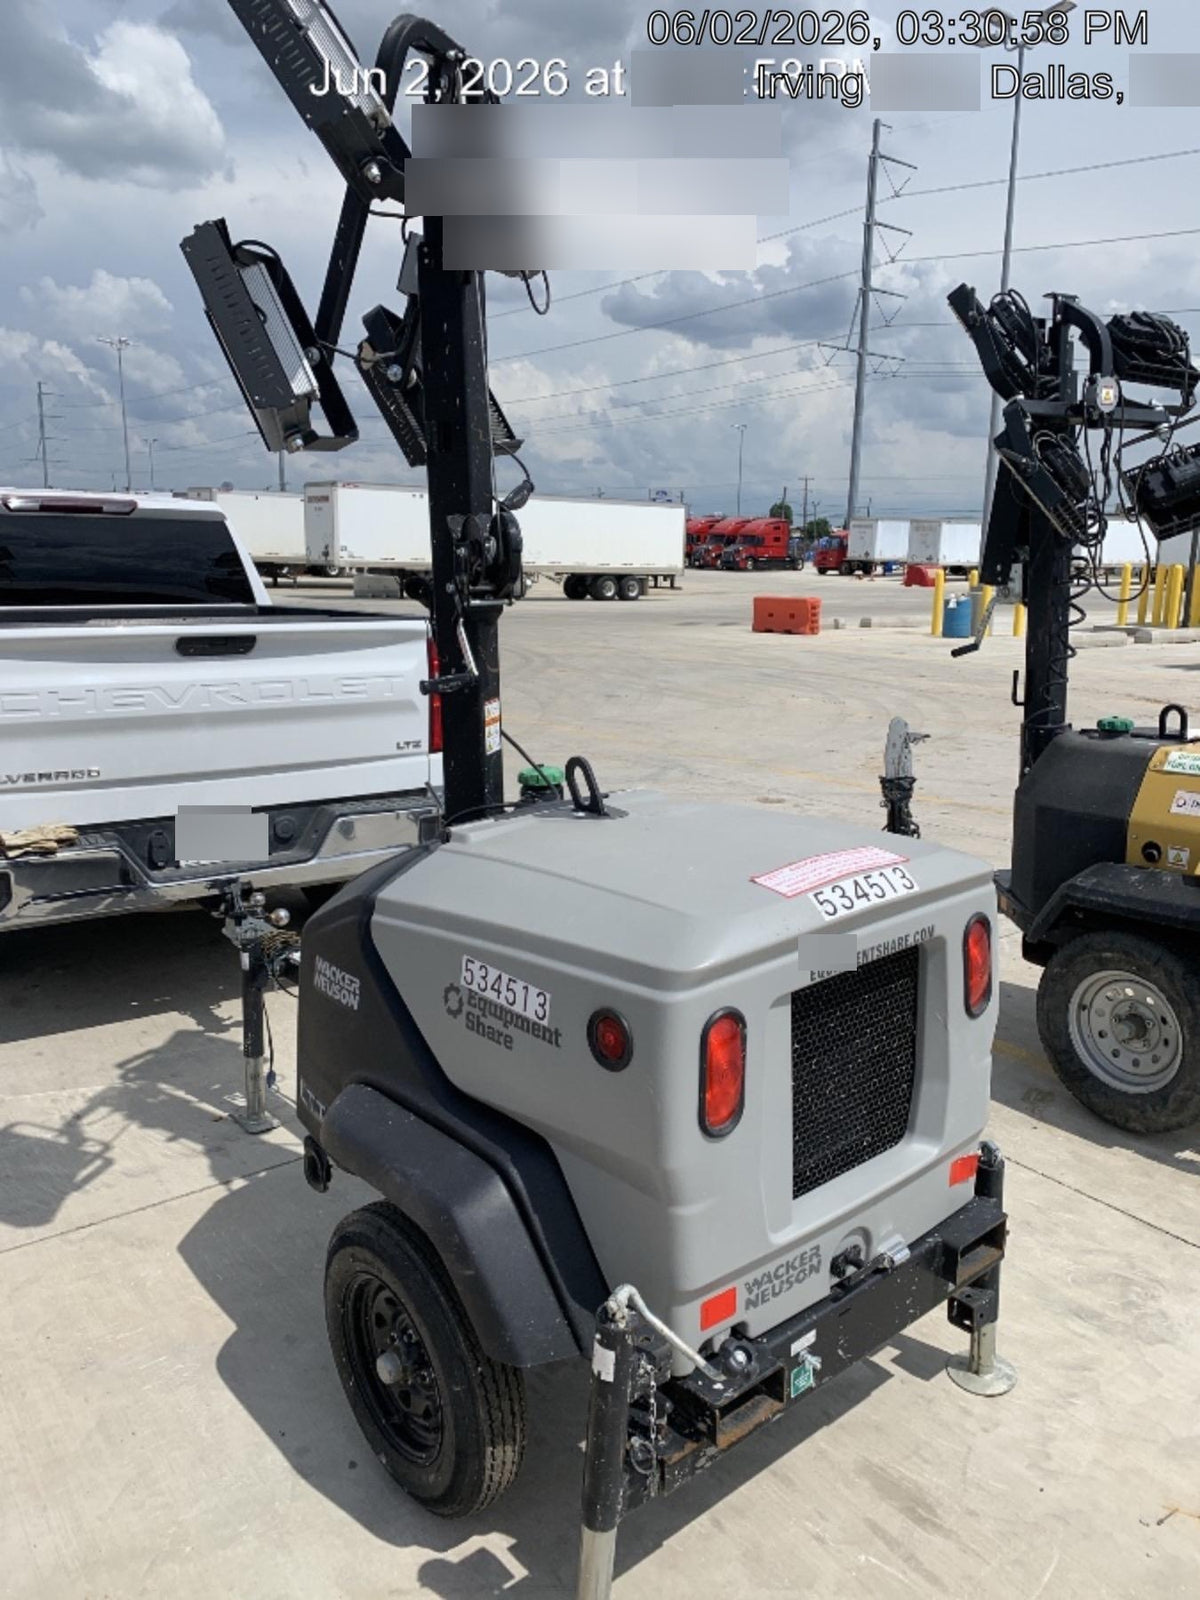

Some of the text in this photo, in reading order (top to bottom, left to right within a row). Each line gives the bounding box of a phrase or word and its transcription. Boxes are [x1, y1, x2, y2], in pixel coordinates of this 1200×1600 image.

[0, 674, 405, 718] CHEVROLET
[396, 739, 422, 752] LTZ
[812, 866, 915, 917] 534513
[313, 973, 361, 1011] NEUSON
[315, 954, 361, 995] WACKER
[463, 957, 548, 1022] 534513
[464, 1010, 515, 1052] Share
[744, 1243, 823, 1295] WACKER
[744, 1257, 823, 1311] NEUSON
